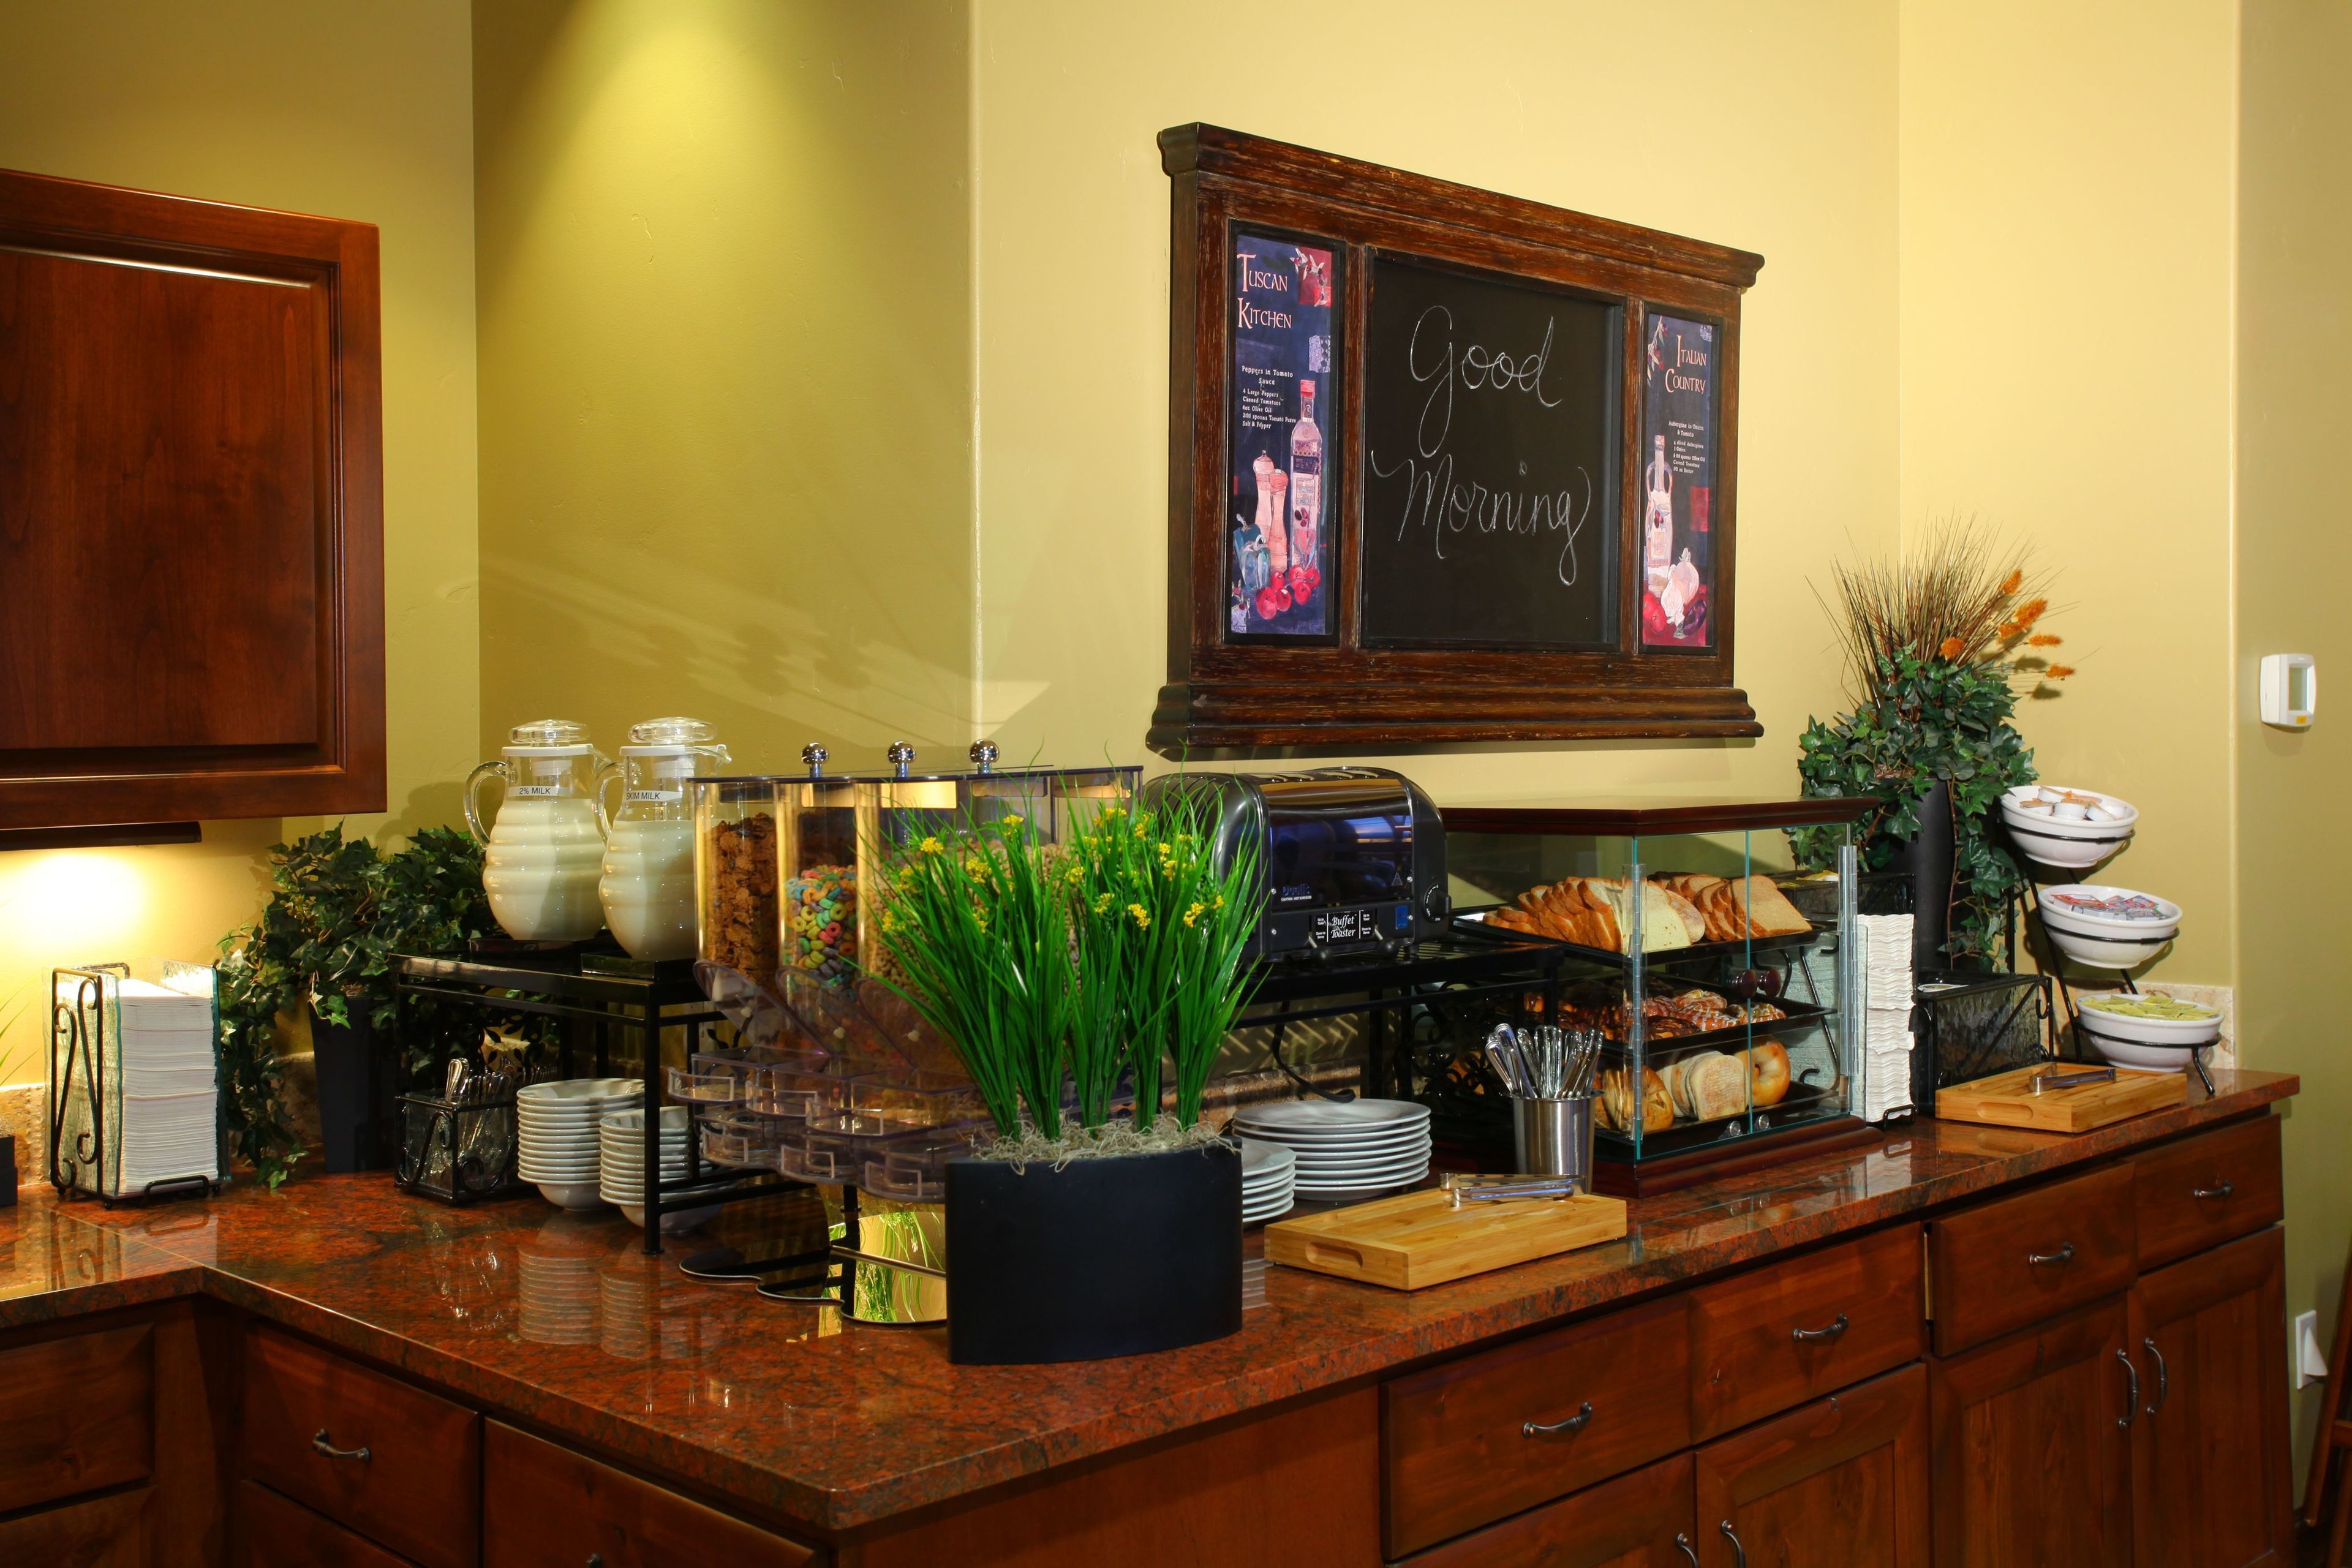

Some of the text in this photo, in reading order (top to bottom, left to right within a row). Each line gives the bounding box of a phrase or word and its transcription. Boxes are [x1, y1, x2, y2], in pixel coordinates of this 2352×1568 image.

[1237, 254, 1287, 292] TUSCAN
[1237, 298, 1292, 329] KITCHEN
[1676, 334, 1706, 367] ITALIAN
[1242, 366, 1263, 375] Peppers
[1273, 369, 1294, 378] Tomato
[1410, 306, 1562, 458] Good
[1665, 369, 1706, 394] COUNTRY
[1371, 450, 1591, 586] Morning
[1330, 929, 1355, 938] Toaster
[1332, 915, 1355, 928] Buffet
